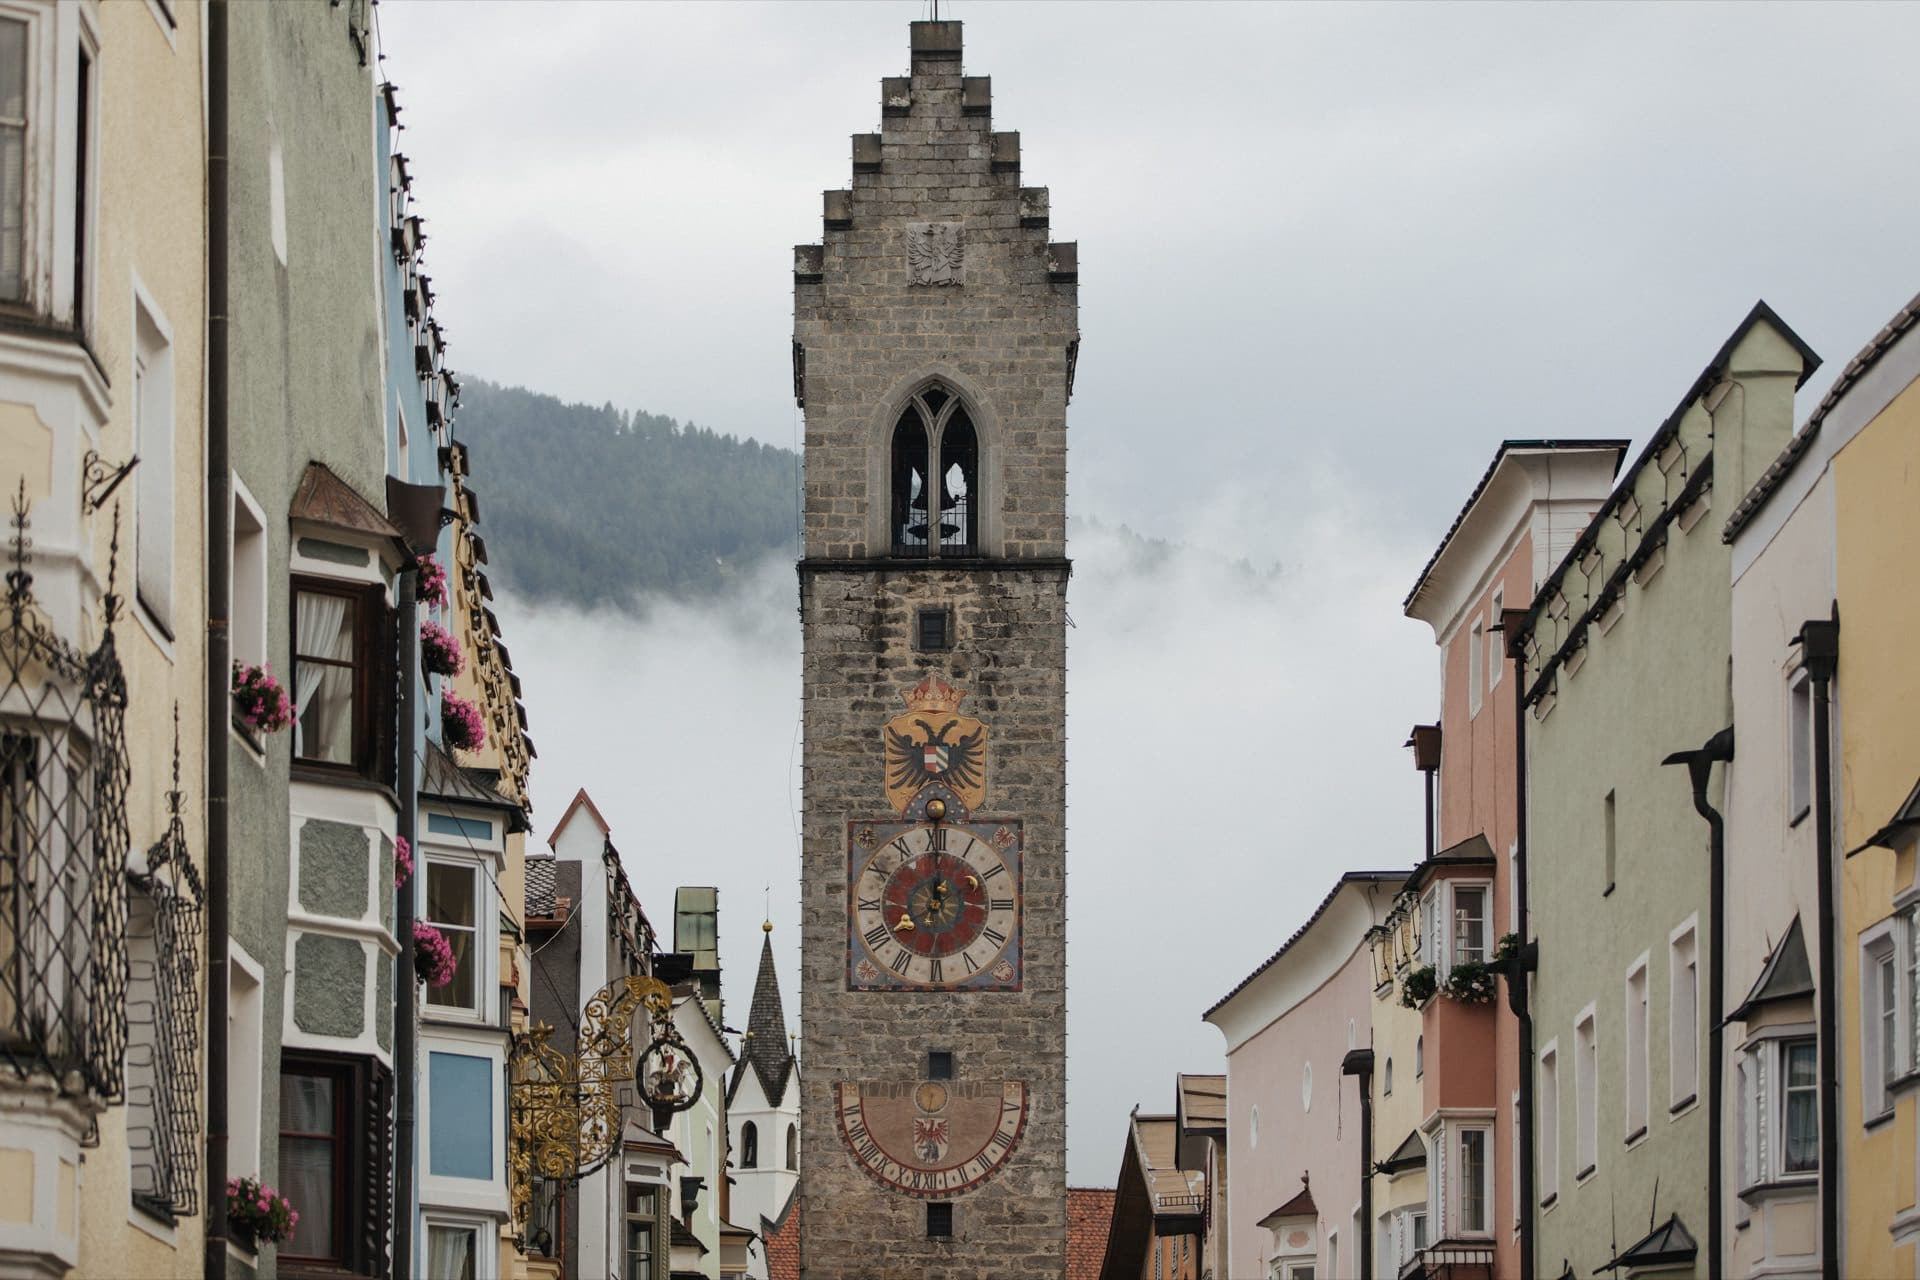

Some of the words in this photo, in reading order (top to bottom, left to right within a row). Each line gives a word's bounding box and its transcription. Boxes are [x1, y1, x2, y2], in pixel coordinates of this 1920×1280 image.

[890, 836, 914, 861] XI
[924, 829, 947, 851] XII
[961, 838, 976, 858] I
[866, 861, 891, 880] X
[982, 863, 1005, 881] II
[857, 897, 881, 912] IX
[991, 898, 1014, 911] III
[863, 923, 890, 952] VIII
[983, 927, 1006, 949] IV
[889, 950, 912, 976] VII
[929, 960, 944, 982] VI
[962, 952, 980, 974] V
[844, 1104, 860, 1116] VI
[1003, 1102, 1020, 1112] V
[848, 1122, 867, 1141] VII
[992, 1129, 1013, 1149] IIII
[859, 1139, 880, 1162] VIII
[875, 1156, 892, 1174] IX
[976, 1152, 993, 1171] III
[895, 1167, 907, 1185] X
[909, 1172, 921, 1188] XI
[922, 1172, 937, 1189] XII
[943, 1171, 948, 1188] I
[957, 1166, 969, 1184] II
